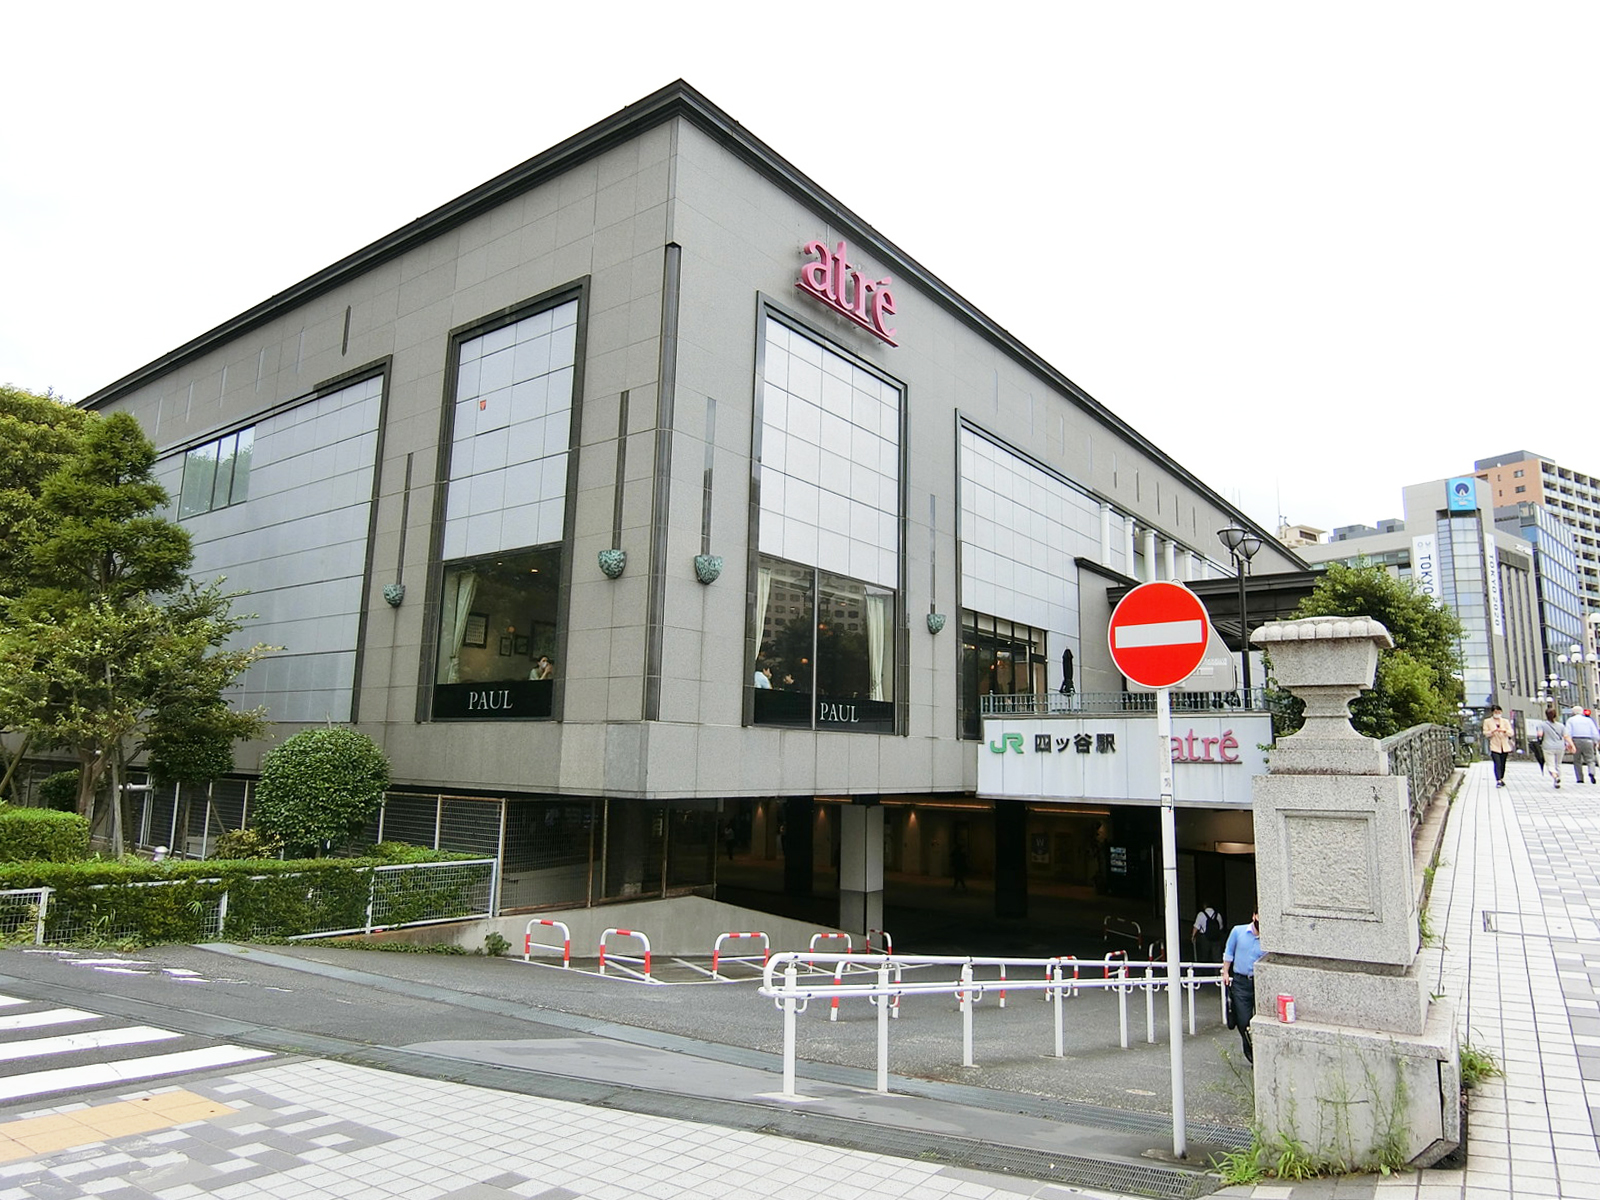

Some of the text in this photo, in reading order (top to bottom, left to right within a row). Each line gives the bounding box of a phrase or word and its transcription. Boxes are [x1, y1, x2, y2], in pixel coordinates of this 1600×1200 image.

[801, 240, 897, 337] atré
[1420, 554, 1434, 595] TOKYO
[1489, 555, 1498, 593] TOKYO
[468, 690, 513, 710] PAUL
[820, 703, 859, 722] PAUL
[990, 733, 1024, 754] JR
[1171, 728, 1239, 762] atré
